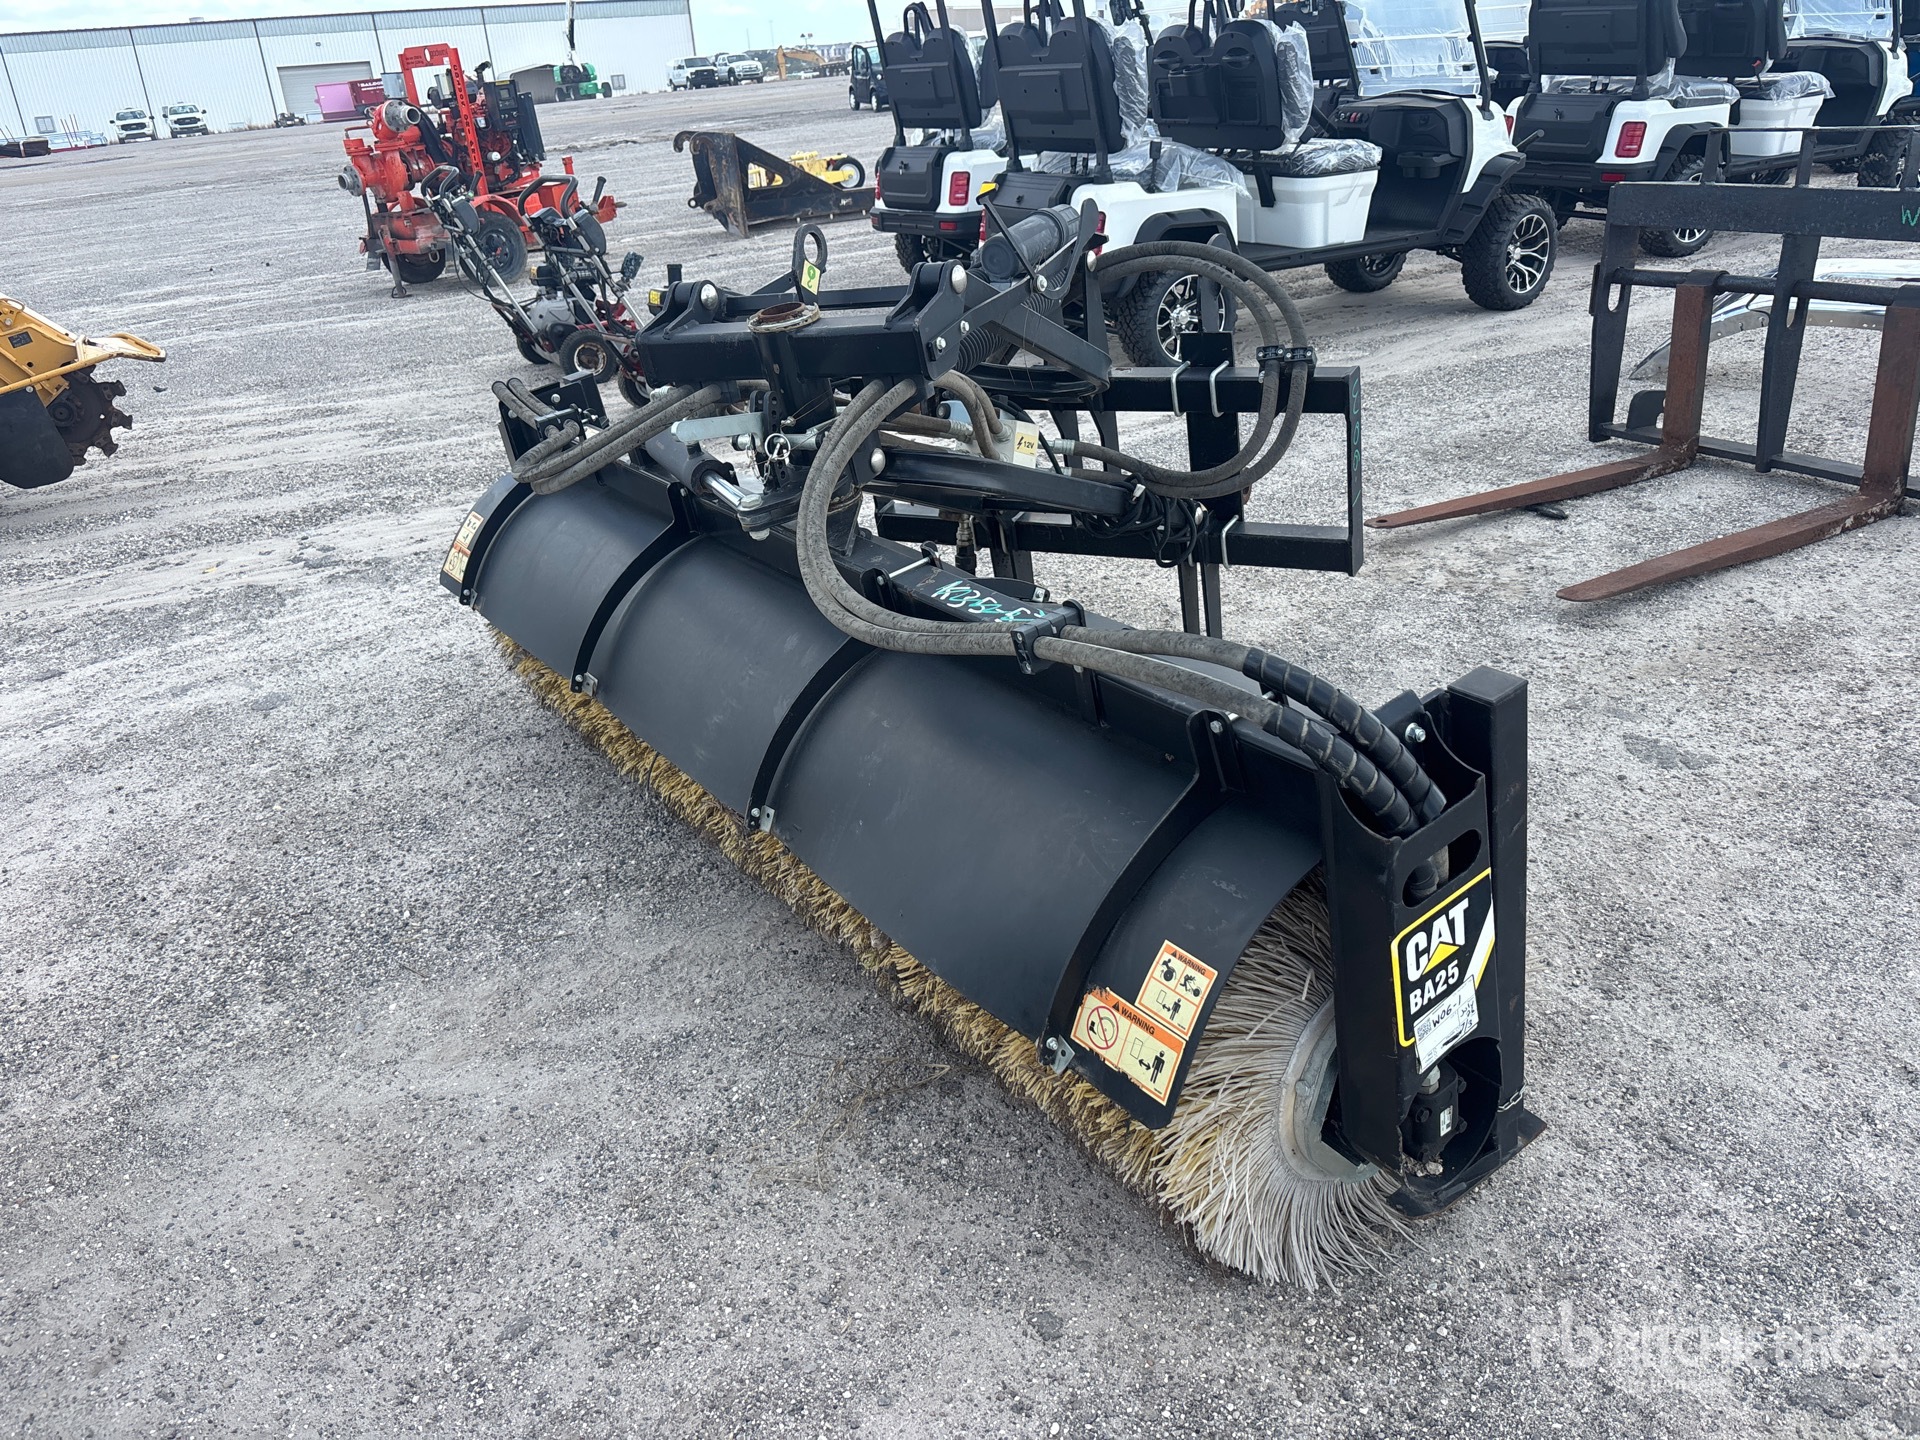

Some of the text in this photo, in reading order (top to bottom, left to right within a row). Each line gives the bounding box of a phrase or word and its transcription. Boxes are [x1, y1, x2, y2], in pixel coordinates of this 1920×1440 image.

[470, 140, 480, 169] PRIM
[1023, 441, 1035, 450] 12V
[1406, 897, 1469, 982] CAT
[1177, 953, 1207, 976] WARNING
[1410, 960, 1460, 1015] BA25
[1120, 1005, 1155, 1036] WARNING
[1432, 994, 1462, 1028] W06-1
